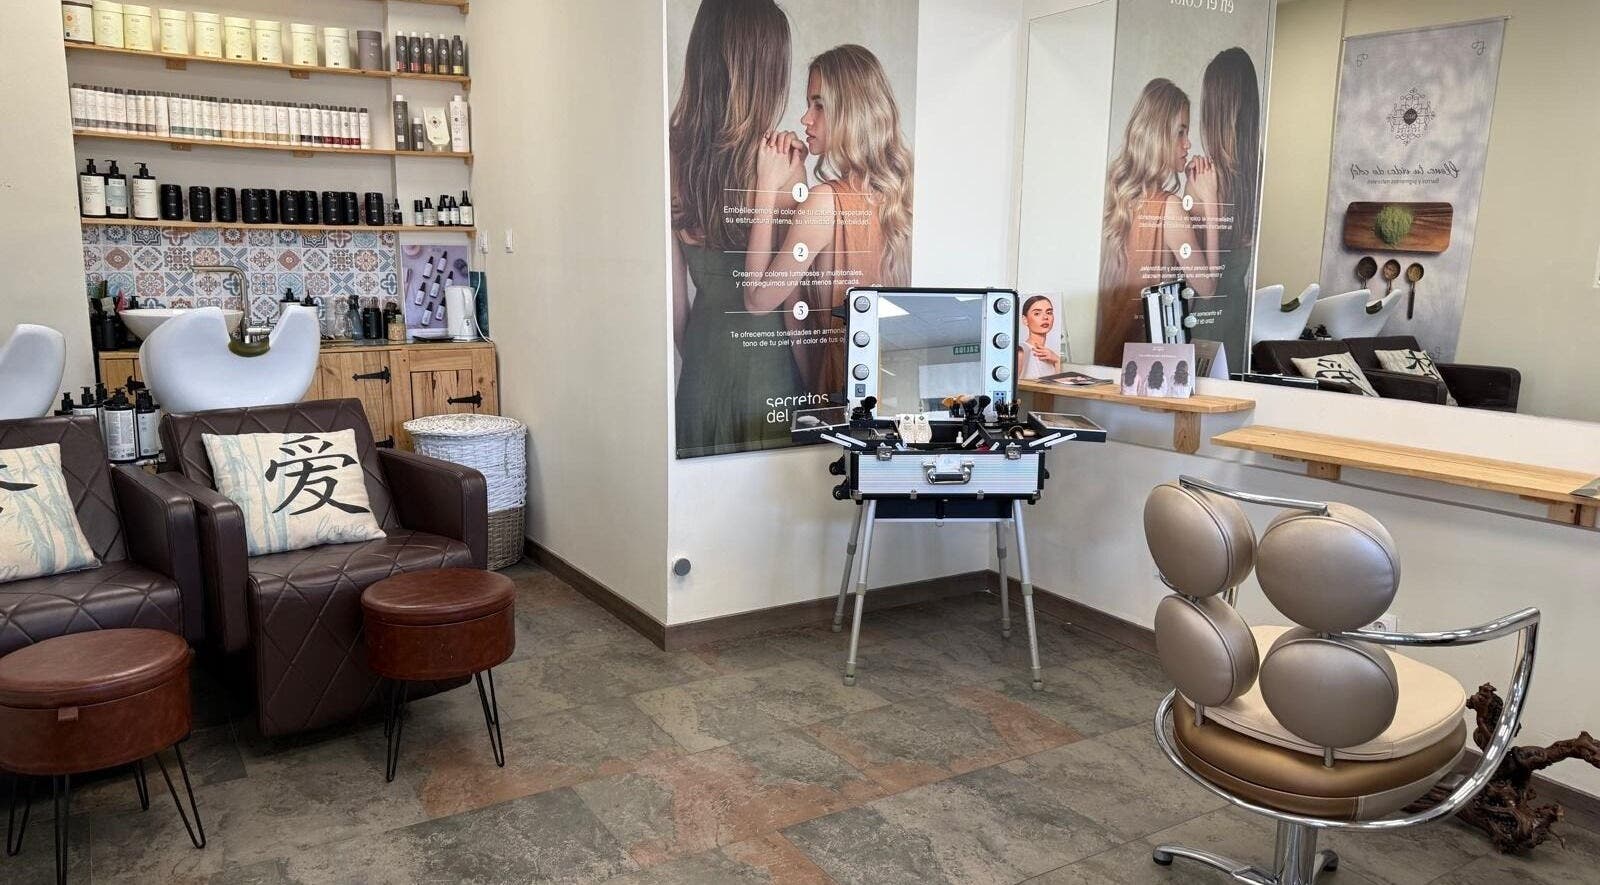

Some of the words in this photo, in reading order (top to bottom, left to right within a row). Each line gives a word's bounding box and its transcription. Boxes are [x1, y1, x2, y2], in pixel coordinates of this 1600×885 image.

[797, 187, 803, 198] 1
[723, 206, 773, 215] Embellecemos
[774, 207, 780, 215] el
[798, 208, 806, 216] de
[838, 209, 873, 218] respetando
[770, 217, 794, 226] interna,
[797, 247, 804, 258] 2
[732, 269, 763, 278] Creamos
[764, 269, 788, 278] colores
[789, 269, 820, 278] luminosos
[826, 269, 865, 279] multitonales,
[741, 280, 786, 289] conseguimos
[833, 278, 860, 287] marcada.
[798, 305, 804, 316] 3
[730, 331, 739, 339] Te
[740, 330, 776, 339] ofrecemos
[776, 328, 812, 338] tonalidades
[742, 340, 758, 348] tono
[759, 339, 768, 348] de
[769, 339, 777, 347] tu
[777, 338, 790, 348] piel
[796, 337, 802, 345] el
[802, 337, 818, 345] color
[819, 336, 828, 344] de
[828, 336, 838, 344] tus
[766, 392, 830, 408] secretos
[766, 408, 790, 424] del
